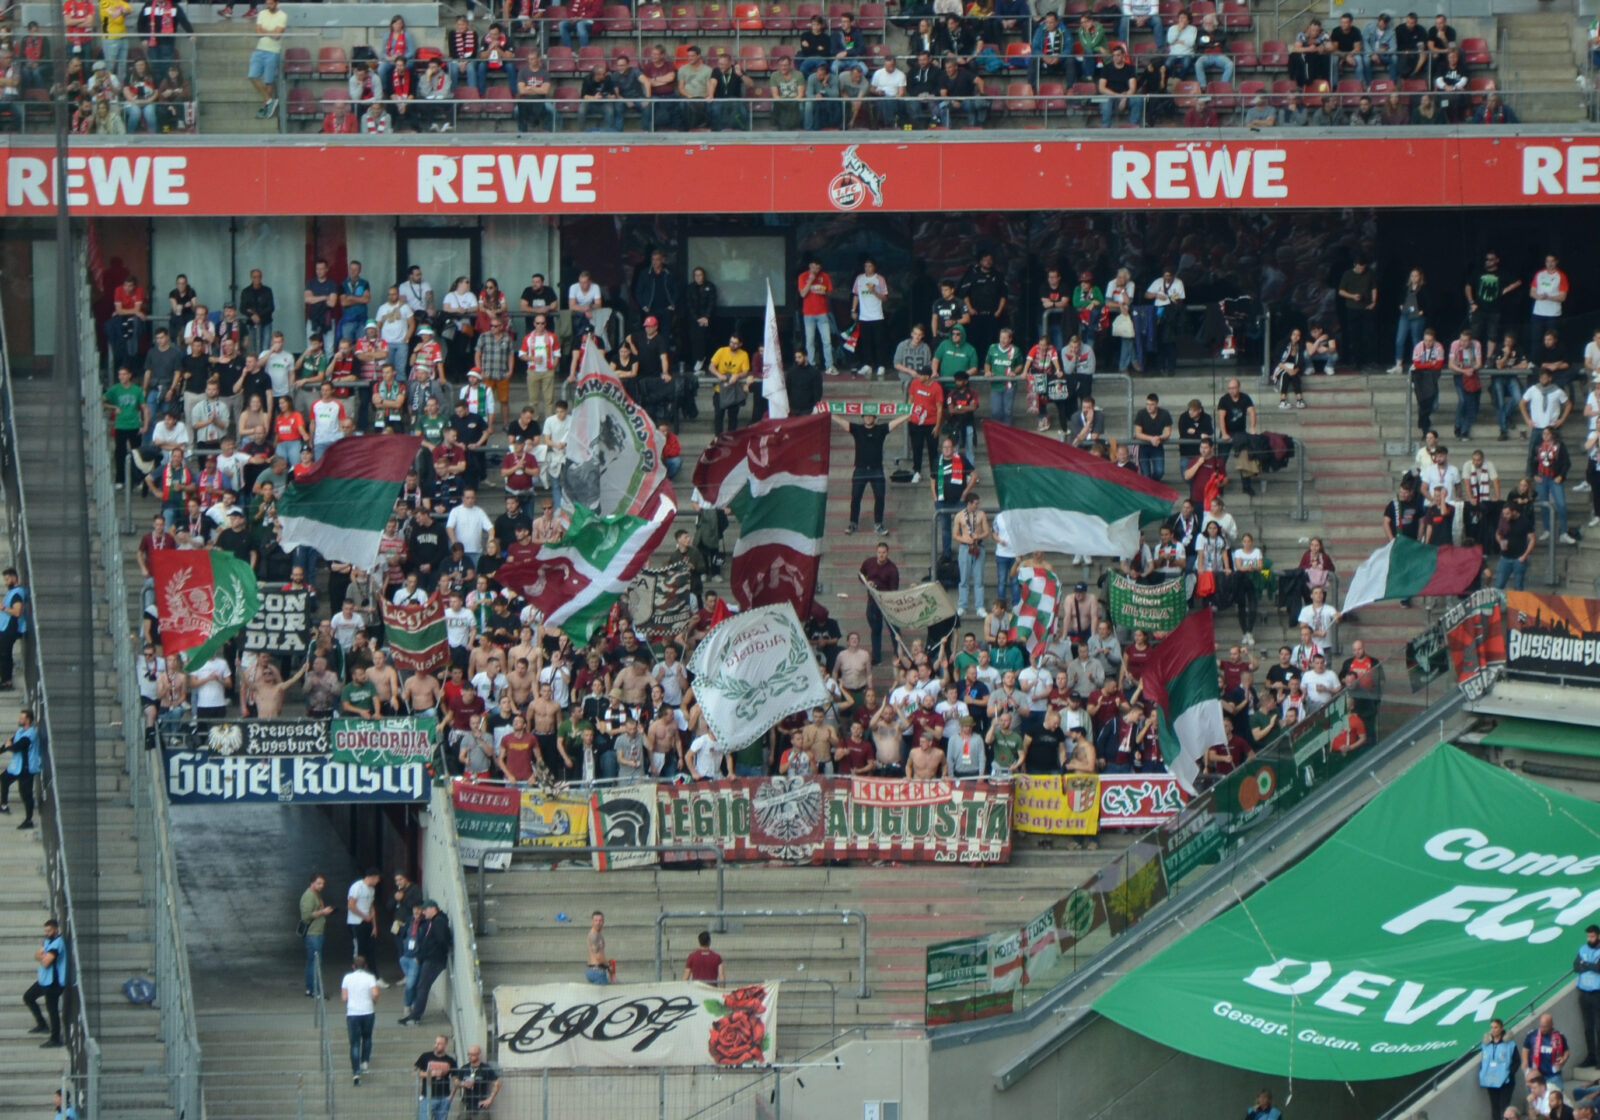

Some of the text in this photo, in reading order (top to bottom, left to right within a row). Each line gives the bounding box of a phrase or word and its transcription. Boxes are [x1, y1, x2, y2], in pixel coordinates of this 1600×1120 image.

[7, 156, 190, 206] REWE
[416, 154, 597, 203] REWE
[1111, 150, 1288, 199] REWE
[256, 593, 308, 612] CON
[246, 612, 306, 631] COR
[244, 632, 306, 650] DIA
[336, 730, 429, 751] CONCORDIA
[169, 752, 282, 799] Gaffel
[853, 780, 950, 801] KICKERS
[1017, 775, 1060, 791] Frei
[458, 791, 511, 807] WEITER
[658, 797, 749, 840] LEGIO
[826, 800, 1010, 842] AUGUSTA
[1015, 812, 1086, 830] Bayern
[959, 850, 1000, 862] MMVII
[1424, 828, 1600, 876] Come
[1242, 957, 1528, 1025] DEVK
[1212, 1001, 1289, 1037] Gesagt.
[1297, 1028, 1361, 1051] Getan.
